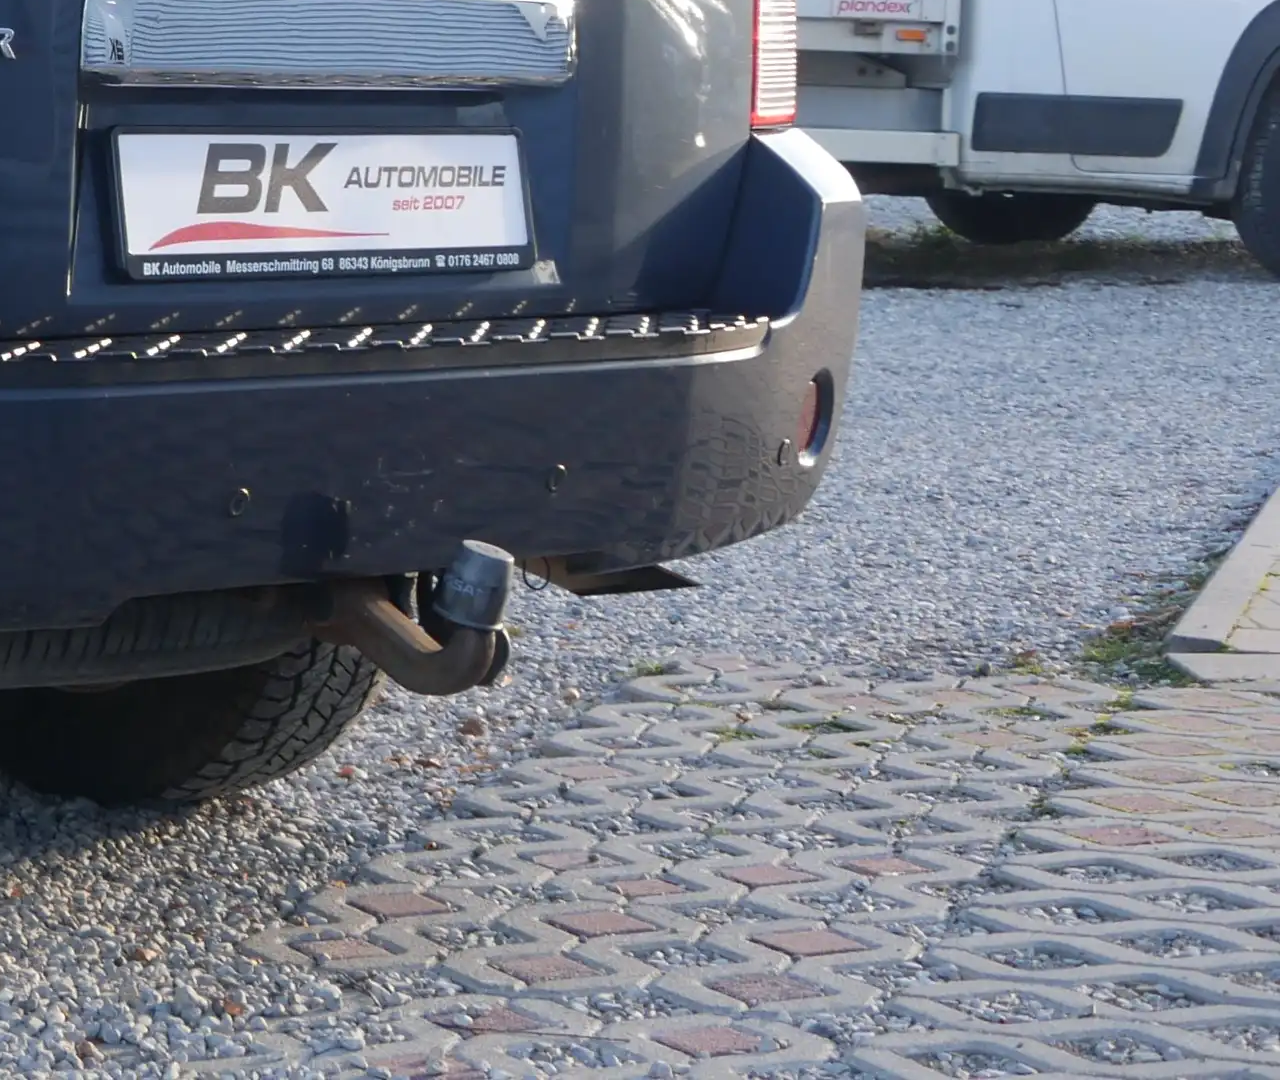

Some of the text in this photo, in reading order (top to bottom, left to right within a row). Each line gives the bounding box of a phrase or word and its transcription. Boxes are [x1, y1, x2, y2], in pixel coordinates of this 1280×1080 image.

[197, 142, 506, 214] BK AUTOMOBILE
[392, 195, 465, 210] seit 2007
[143, 262, 160, 276] BK
[162, 260, 221, 275] Automobile
[226, 258, 320, 274] Messerschmittring
[321, 257, 334, 270] 68
[339, 257, 368, 270] 86343
[370, 256, 430, 272] Königsbrunn
[448, 254, 470, 267] 0176
[473, 253, 494, 266] 2467
